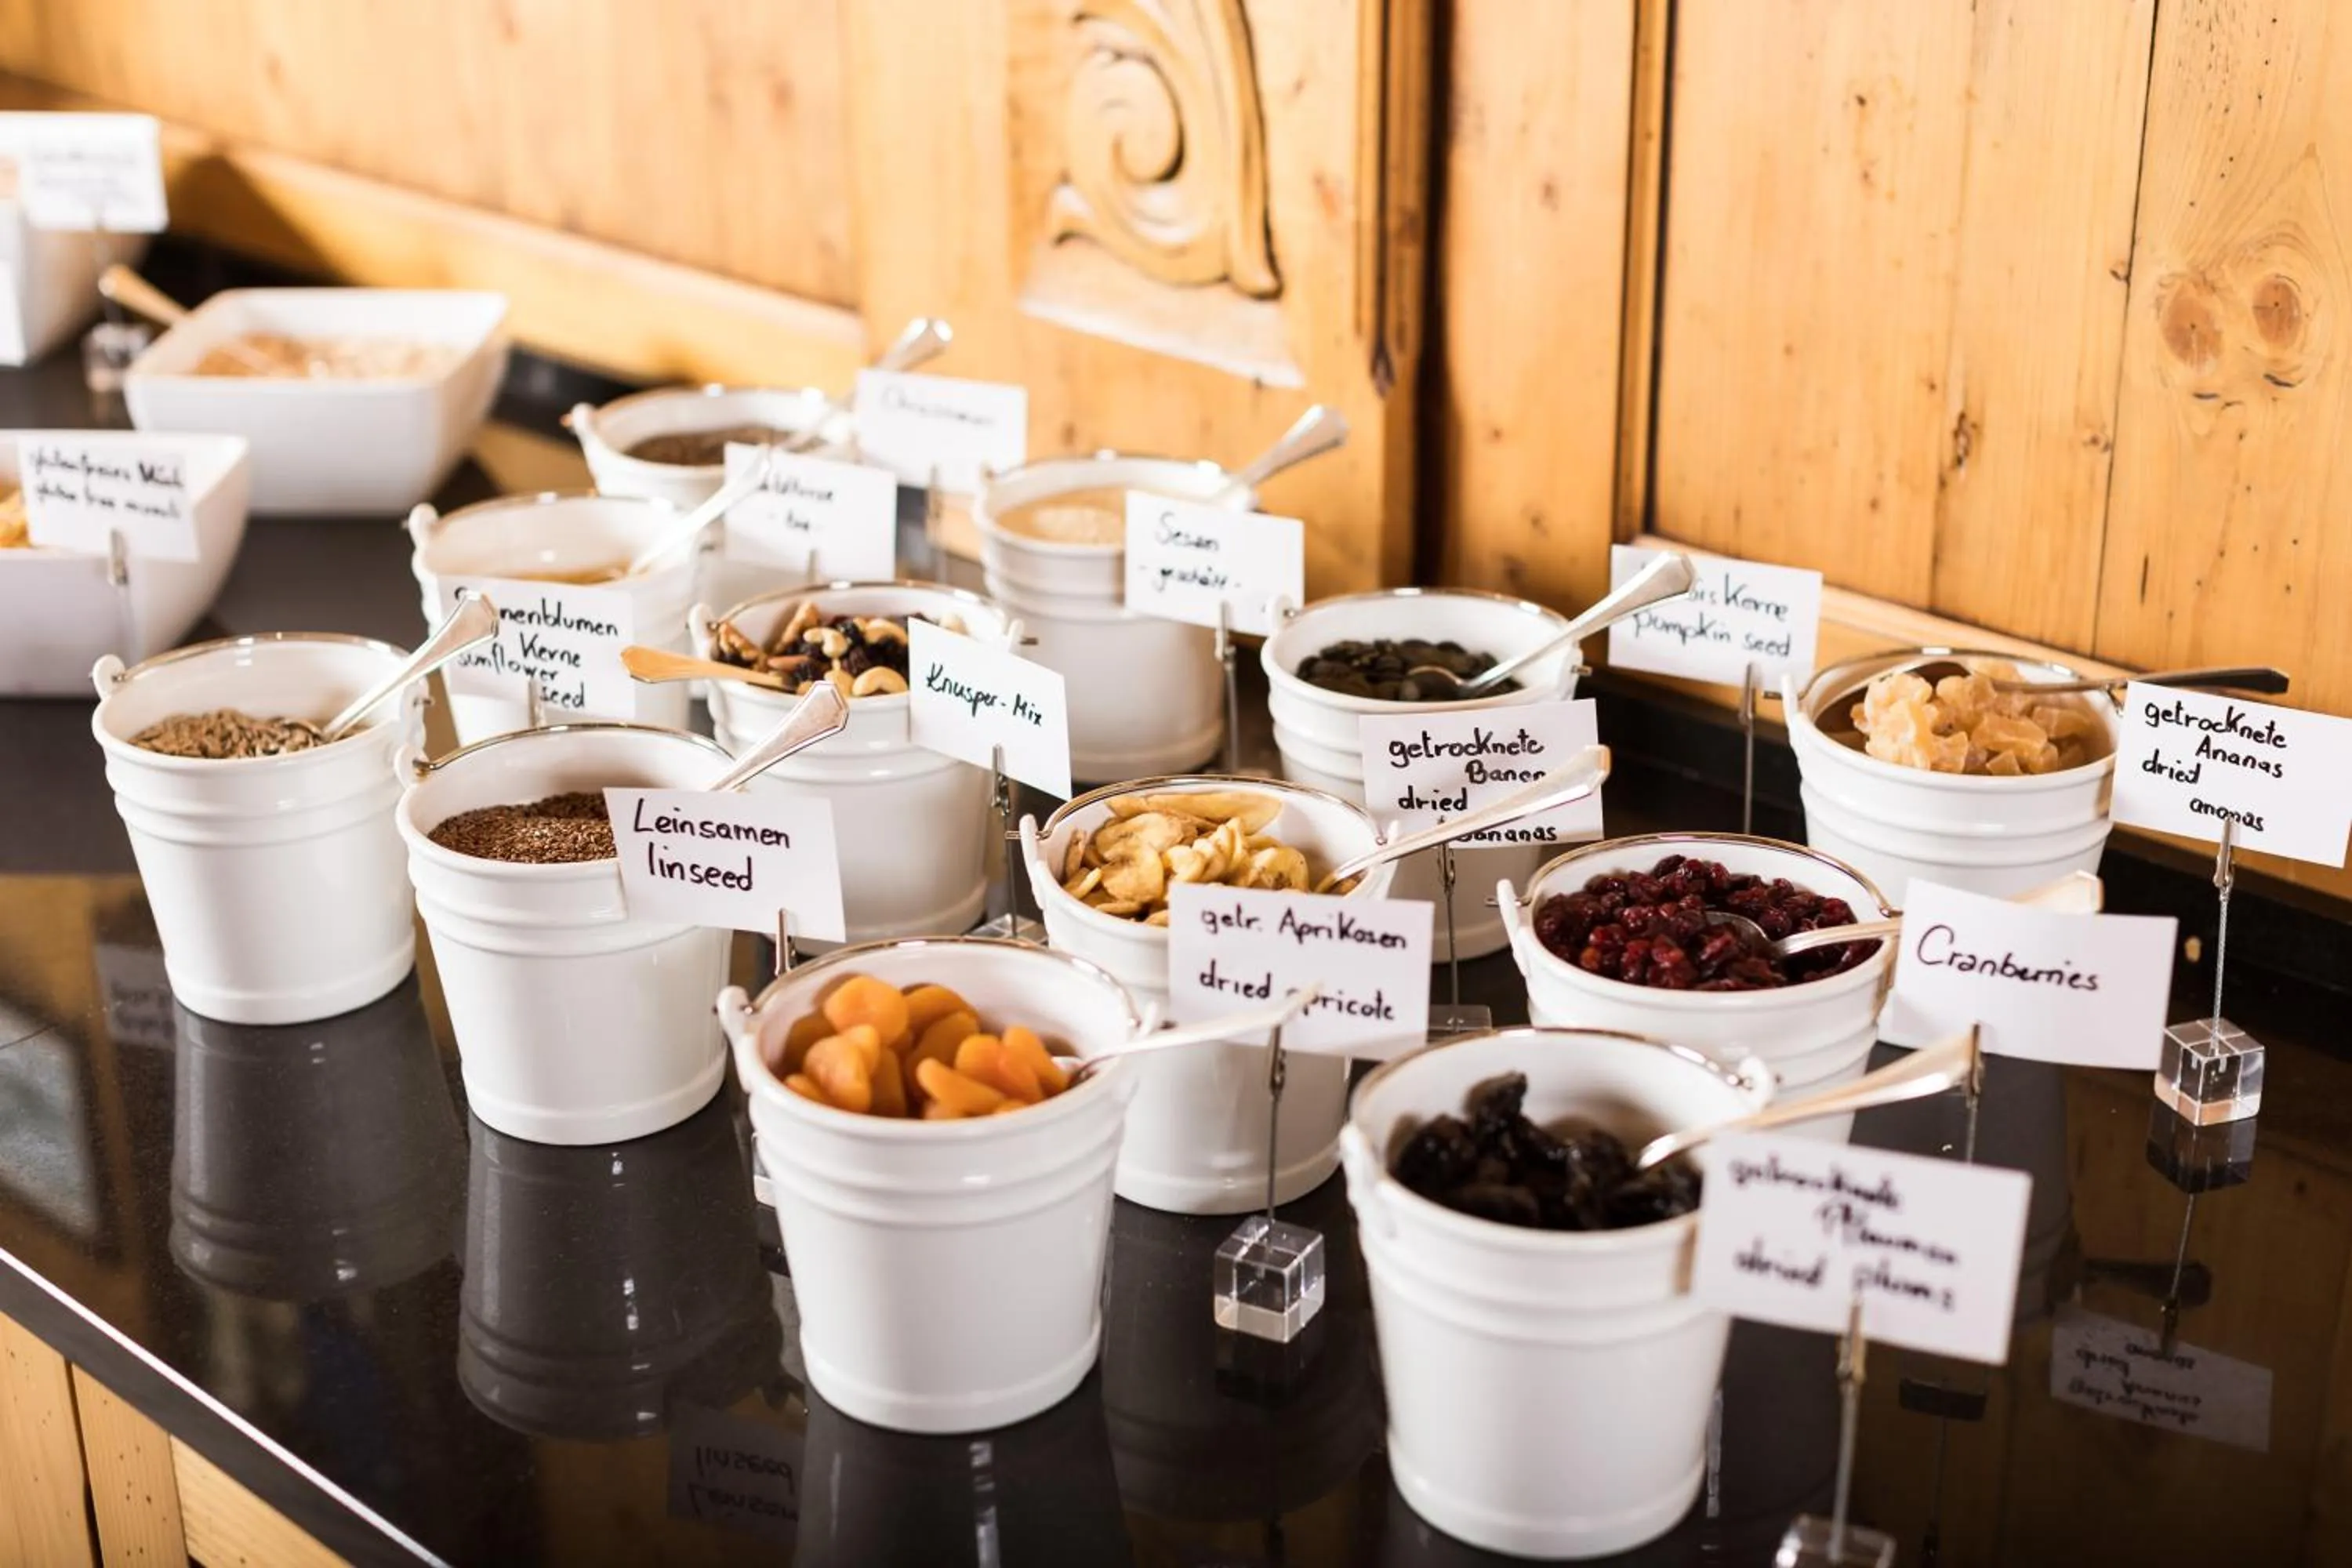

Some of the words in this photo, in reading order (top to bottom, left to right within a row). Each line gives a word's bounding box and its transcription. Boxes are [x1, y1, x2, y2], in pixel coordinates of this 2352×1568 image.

[454, 586, 619, 637] nenblumen
[519, 632, 583, 668] Kerne
[1632, 611, 1732, 646] pumpkin
[1743, 633, 1791, 658] seed
[457, 641, 561, 681] sunflower
[539, 682, 585, 708] seed
[2144, 700, 2288, 749] getrocknete
[1388, 728, 1545, 768] getrocknete
[2142, 748, 2201, 785] dried
[2195, 735, 2283, 779] Ananas
[1465, 759, 1546, 785] Banan
[1398, 786, 1468, 811] dried
[633, 797, 791, 849] Leinsamen
[1456, 826, 1557, 843] ananas
[648, 841, 753, 891] linseed
[1917, 924, 2100, 992] Cranberries
[1200, 958, 1272, 1000] dried
